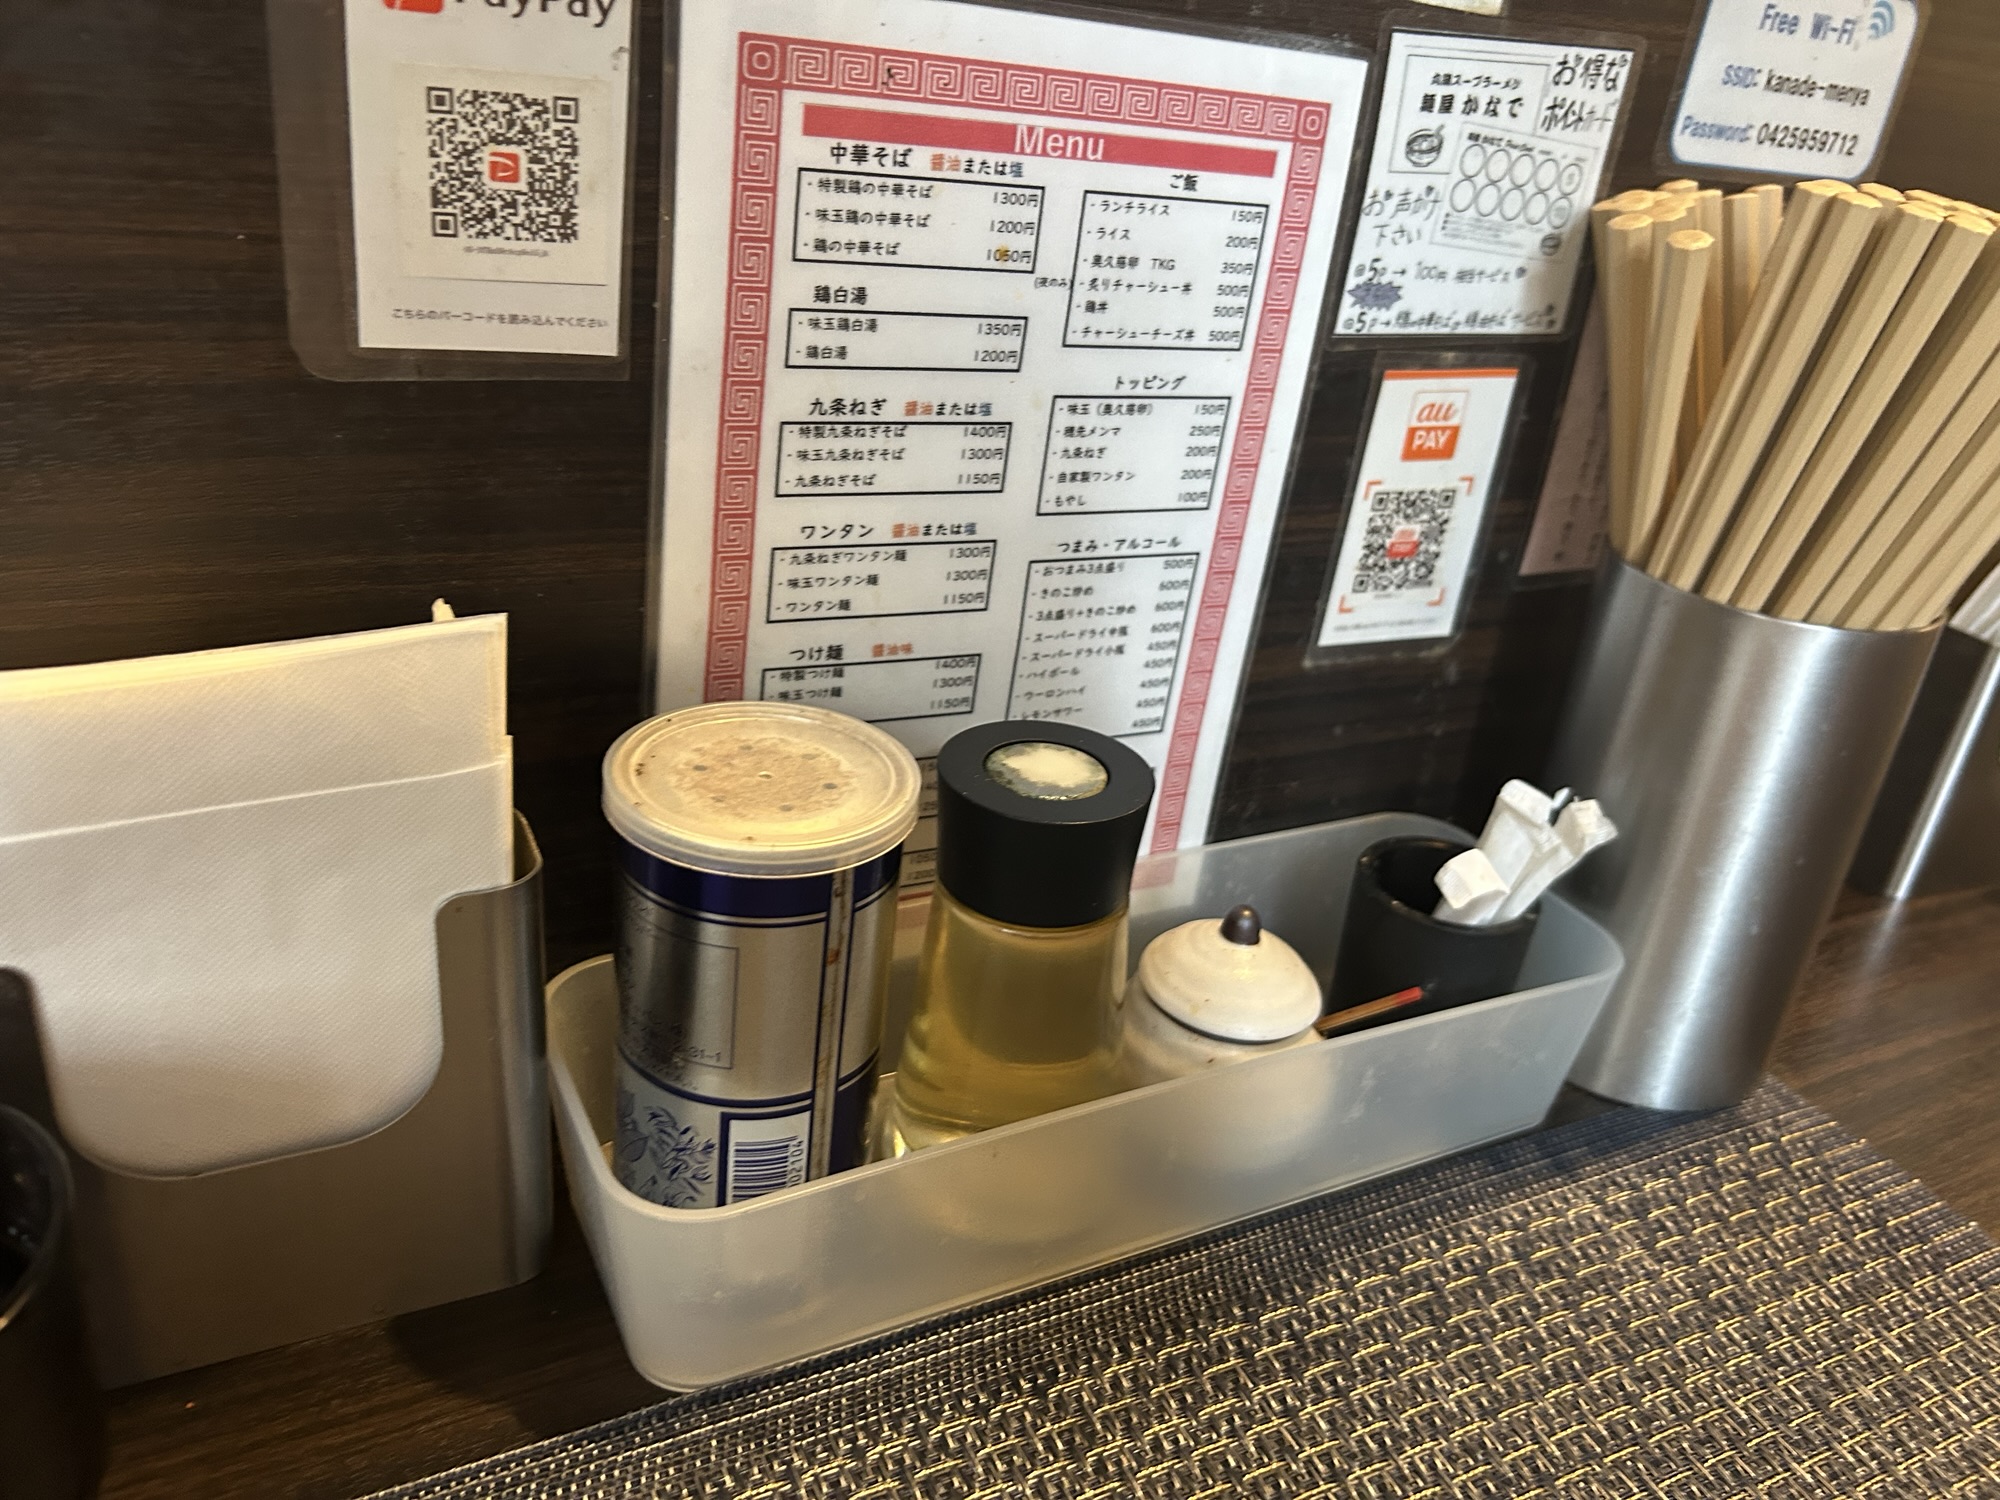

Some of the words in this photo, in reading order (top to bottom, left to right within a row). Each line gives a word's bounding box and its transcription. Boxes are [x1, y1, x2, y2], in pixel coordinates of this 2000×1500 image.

[1759, 3, 1800, 35] Free
[1809, 11, 1857, 45] Wi-Fi
[1763, 68, 1871, 107] kanade-menya
[1014, 125, 1105, 161] Menu
[1756, 122, 1859, 157] 0425959712
[830, 142, 913, 168] 中華そば
[930, 153, 1025, 178] 醤油または塩
[1169, 174, 1199, 192] ご飯
[817, 178, 934, 199] 特製鶏の中華そば
[994, 192, 1039, 207] 1300円
[1100, 199, 1170, 217] ランチライス
[1231, 210, 1263, 224] 150円
[815, 208, 932, 228] 味玉鶏の中華そば
[990, 220, 1035, 235] 1200円
[813, 237, 901, 256] 鶏の中華そば
[1096, 227, 1131, 241] ライス
[1225, 236, 1259, 250] 200円
[1150, 257, 1176, 271] TKG
[1221, 262, 1254, 276] 350円
[813, 285, 868, 306] 鶏白湯
[1216, 284, 1249, 298] 500円
[1213, 305, 1245, 318] 500円
[807, 316, 879, 333] 味玉鶏白湯
[977, 323, 1022, 338] 1350円
[1208, 330, 1241, 343] 500円
[805, 345, 848, 360] 鶏白湯
[974, 350, 1019, 364] 1200円
[1115, 375, 1187, 391] トッピング
[808, 398, 888, 416] 九条ねぎ
[1194, 403, 1225, 416] 150円
[1416, 401, 1457, 423] au
[963, 425, 1007, 439] 1400円
[1189, 425, 1222, 438] 250円
[1412, 429, 1451, 451] PAY
[796, 447, 906, 462] 味玉九条ねぎそば
[961, 448, 1004, 461] 1300円
[1060, 447, 1108, 459] 九条ねぎ
[1185, 445, 1218, 458] 200円
[794, 473, 877, 487] 九条ねぎそば
[957, 473, 1000, 486] 1150円
[1057, 470, 1136, 484] 自家製ワンタン
[1181, 469, 1214, 481] 200円
[1054, 495, 1088, 507] もやし
[801, 523, 875, 540] ワンタン
[1057, 536, 1182, 554] つまみ・アルコール
[789, 550, 908, 566] 九条ねぎワンタン麺
[949, 546, 991, 559] 1300円
[787, 574, 880, 590] 味玉ワンタン麺
[946, 569, 988, 582] 1300円
[785, 599, 852, 613] ワンタン麺
[943, 592, 985, 605] 1150円
[790, 644, 844, 662] つけ麺
[935, 657, 977, 669] 1400円
[932, 676, 974, 689] 1300円
[929, 696, 971, 709] 1150円
